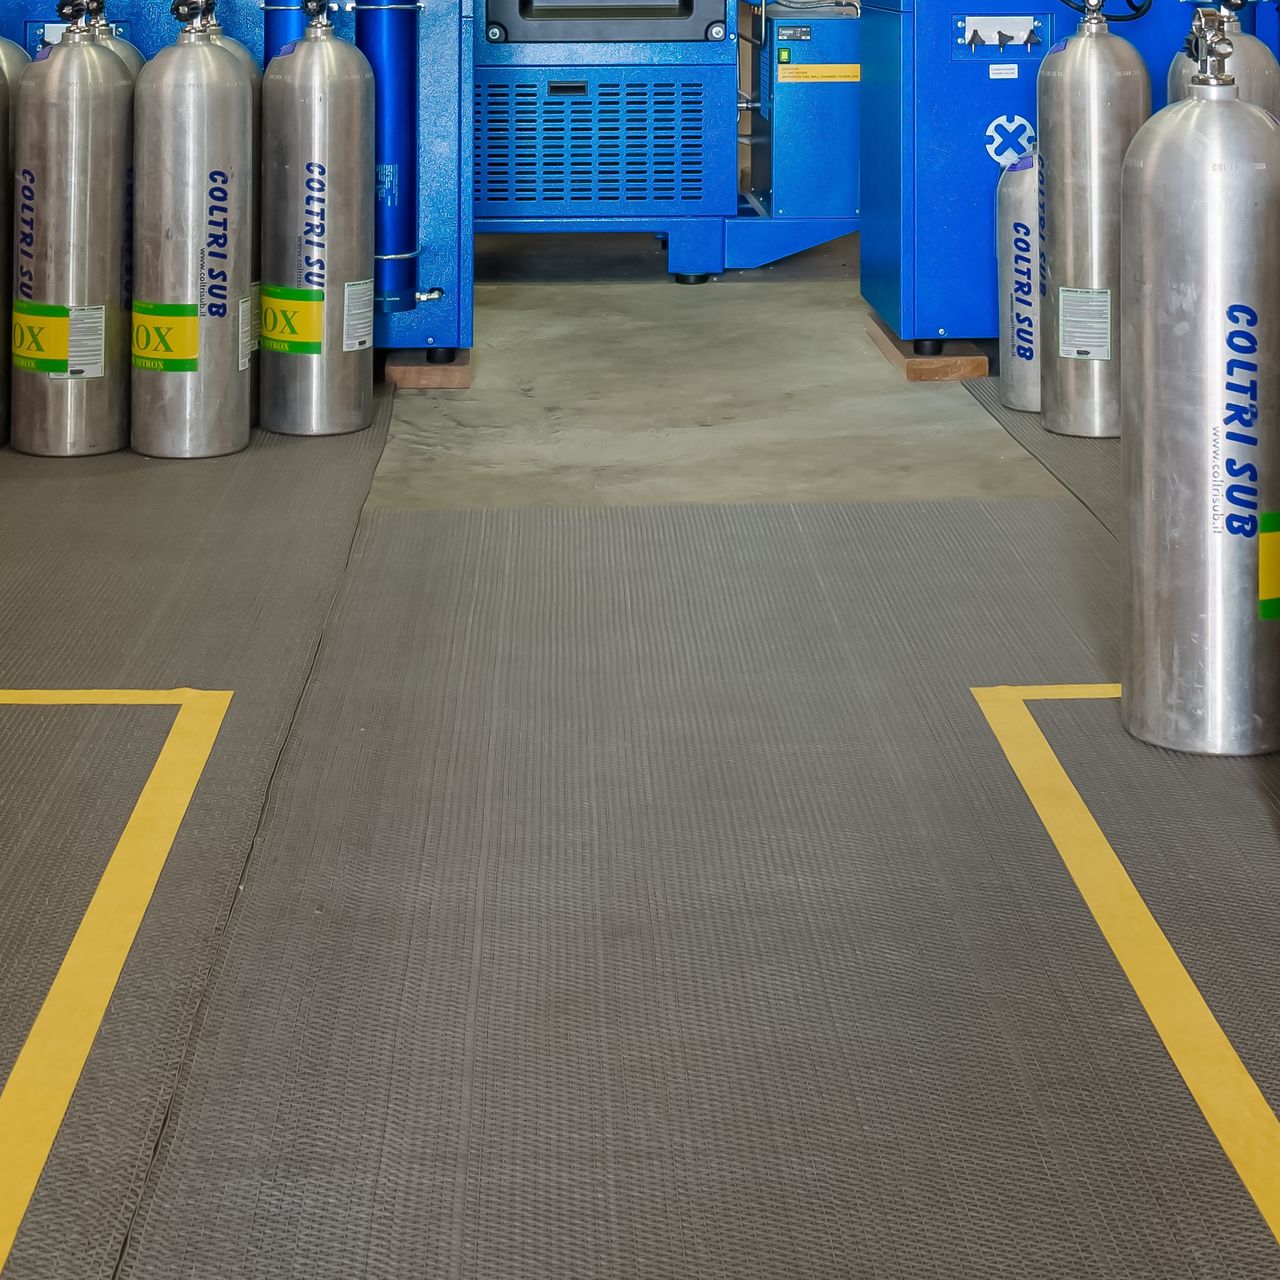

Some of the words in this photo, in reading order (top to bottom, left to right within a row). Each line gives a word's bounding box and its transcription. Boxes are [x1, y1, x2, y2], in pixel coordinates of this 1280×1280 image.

[19, 168, 36, 260] COLTRI
[206, 170, 229, 260] COLTRI
[303, 162, 326, 249] COLTRI
[19, 265, 34, 300] SU
[199, 248, 207, 317] www.coltrisub.it
[207, 267, 228, 319] SUB
[304, 255, 325, 300] SU
[1013, 221, 1033, 308] COLTRI
[132, 323, 175, 353] OX
[1015, 312, 1034, 362] SUB
[1225, 302, 1258, 448] COLTRI
[1212, 426, 1224, 534] www.coltrisub.it
[1225, 460, 1258, 539] SUB
